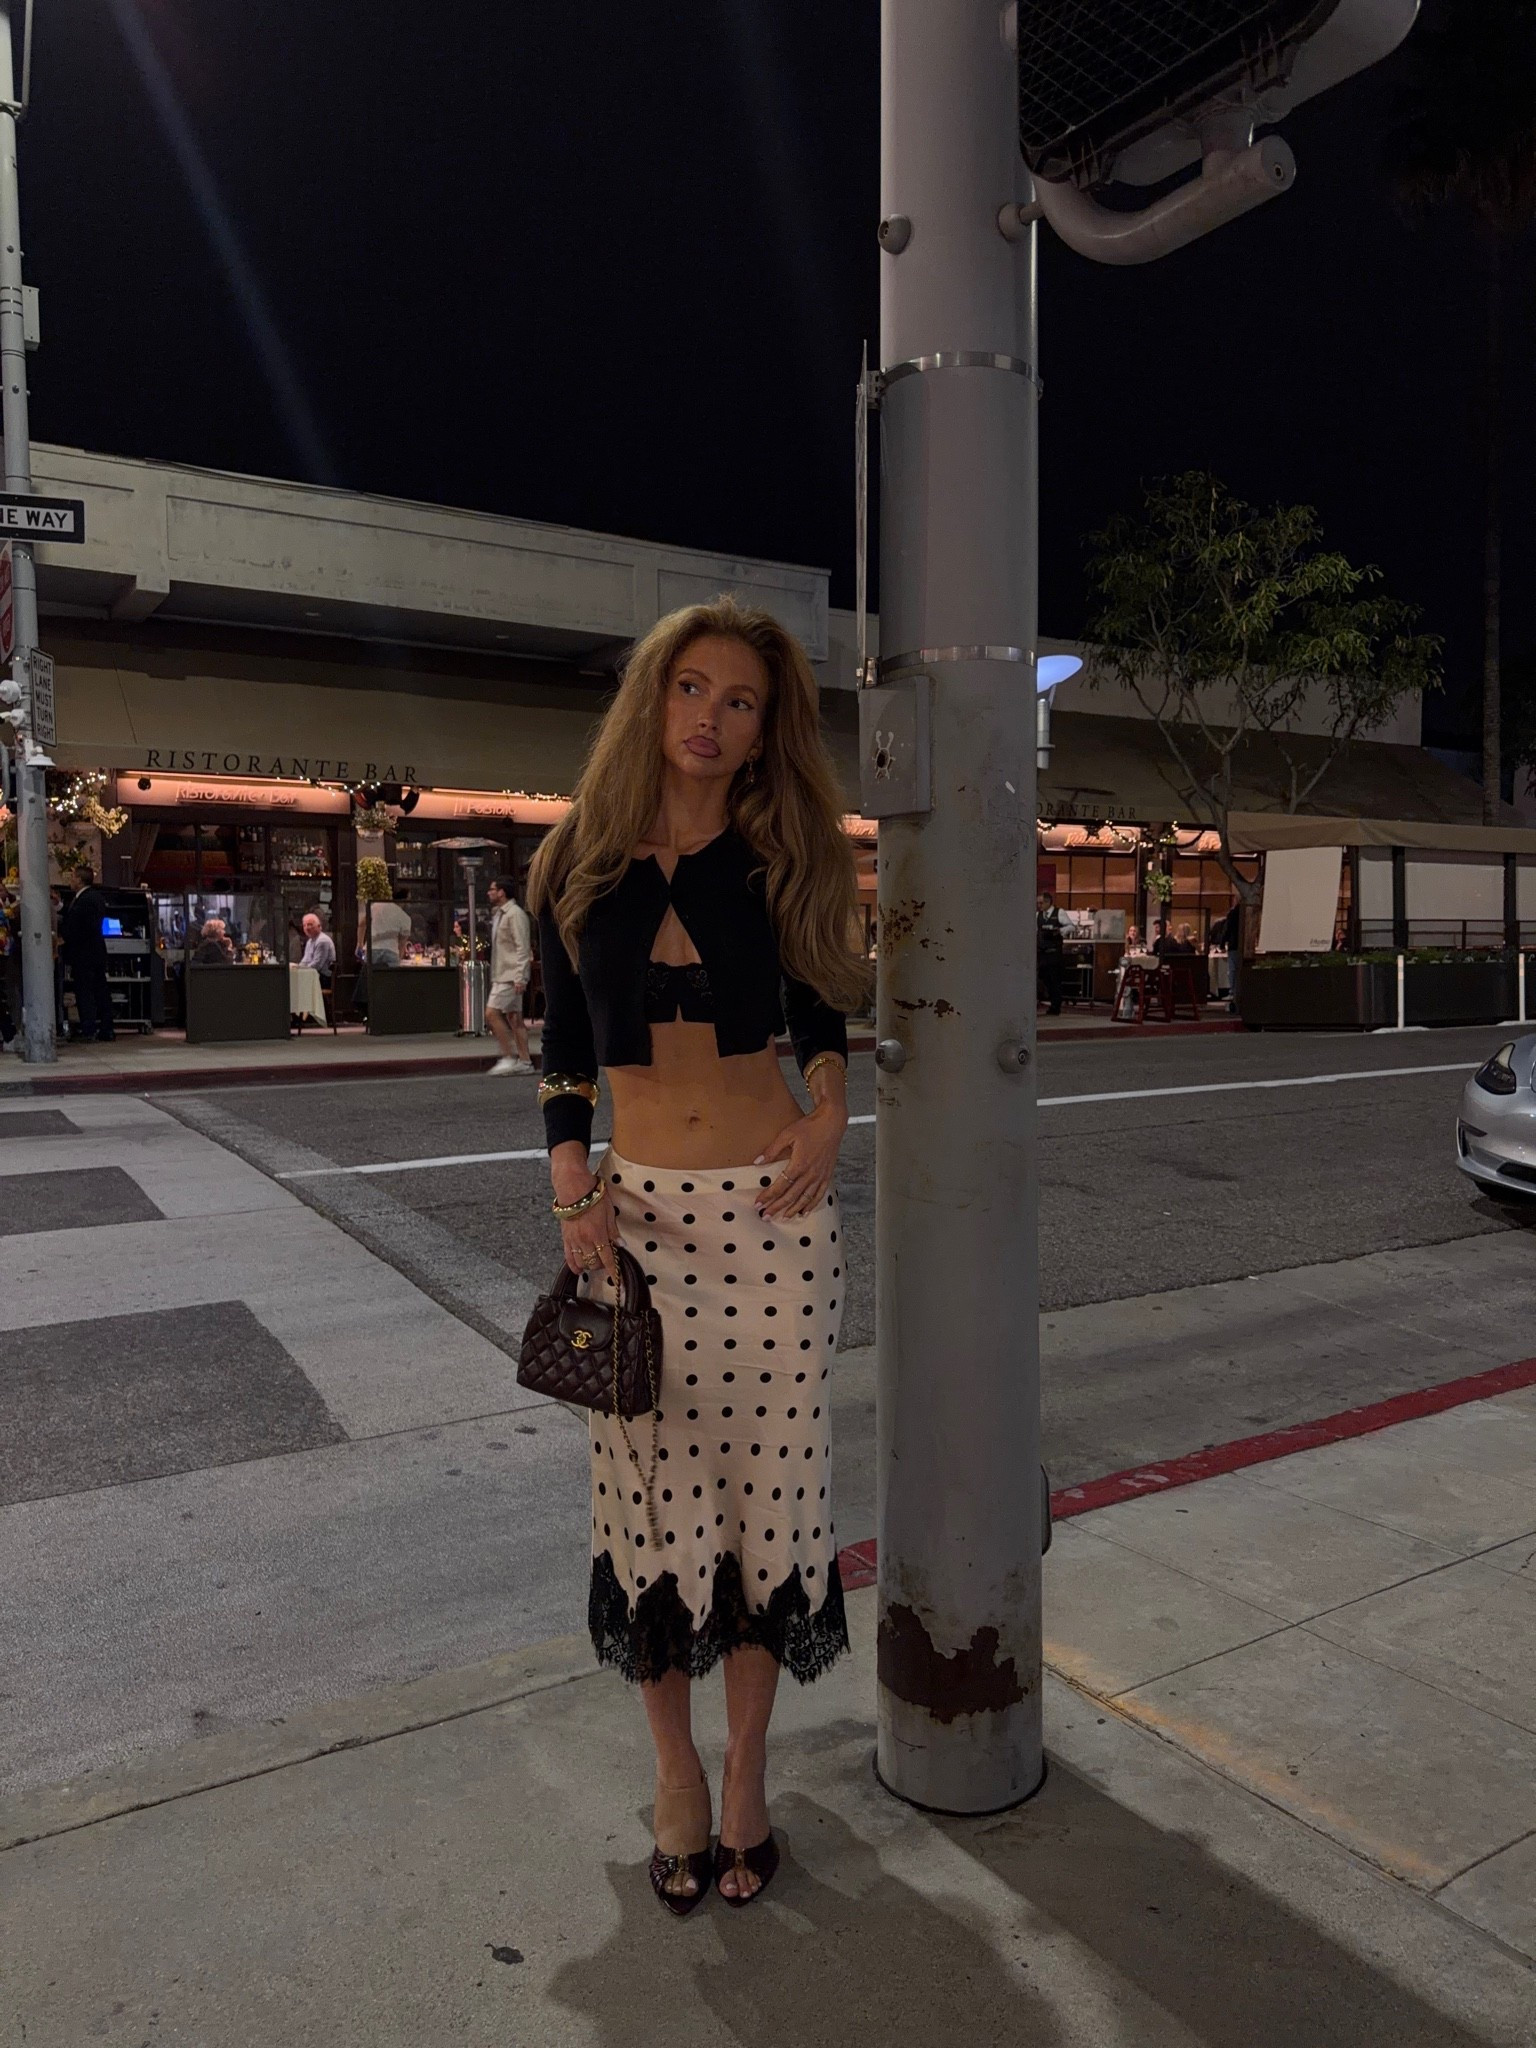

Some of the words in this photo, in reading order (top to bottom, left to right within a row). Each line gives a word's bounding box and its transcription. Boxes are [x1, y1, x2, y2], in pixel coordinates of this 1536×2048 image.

[26, 509, 68, 528] WAY
[33, 655, 51, 675] RIGHT
[34, 673, 52, 692] LANE
[35, 689, 52, 708] MUST
[36, 706, 53, 725] TURN
[36, 723, 54, 741] RIGHT
[145, 749, 350, 779] RISTORANTE
[364, 763, 417, 782] BAR
[1107, 805, 1137, 820] BAR
